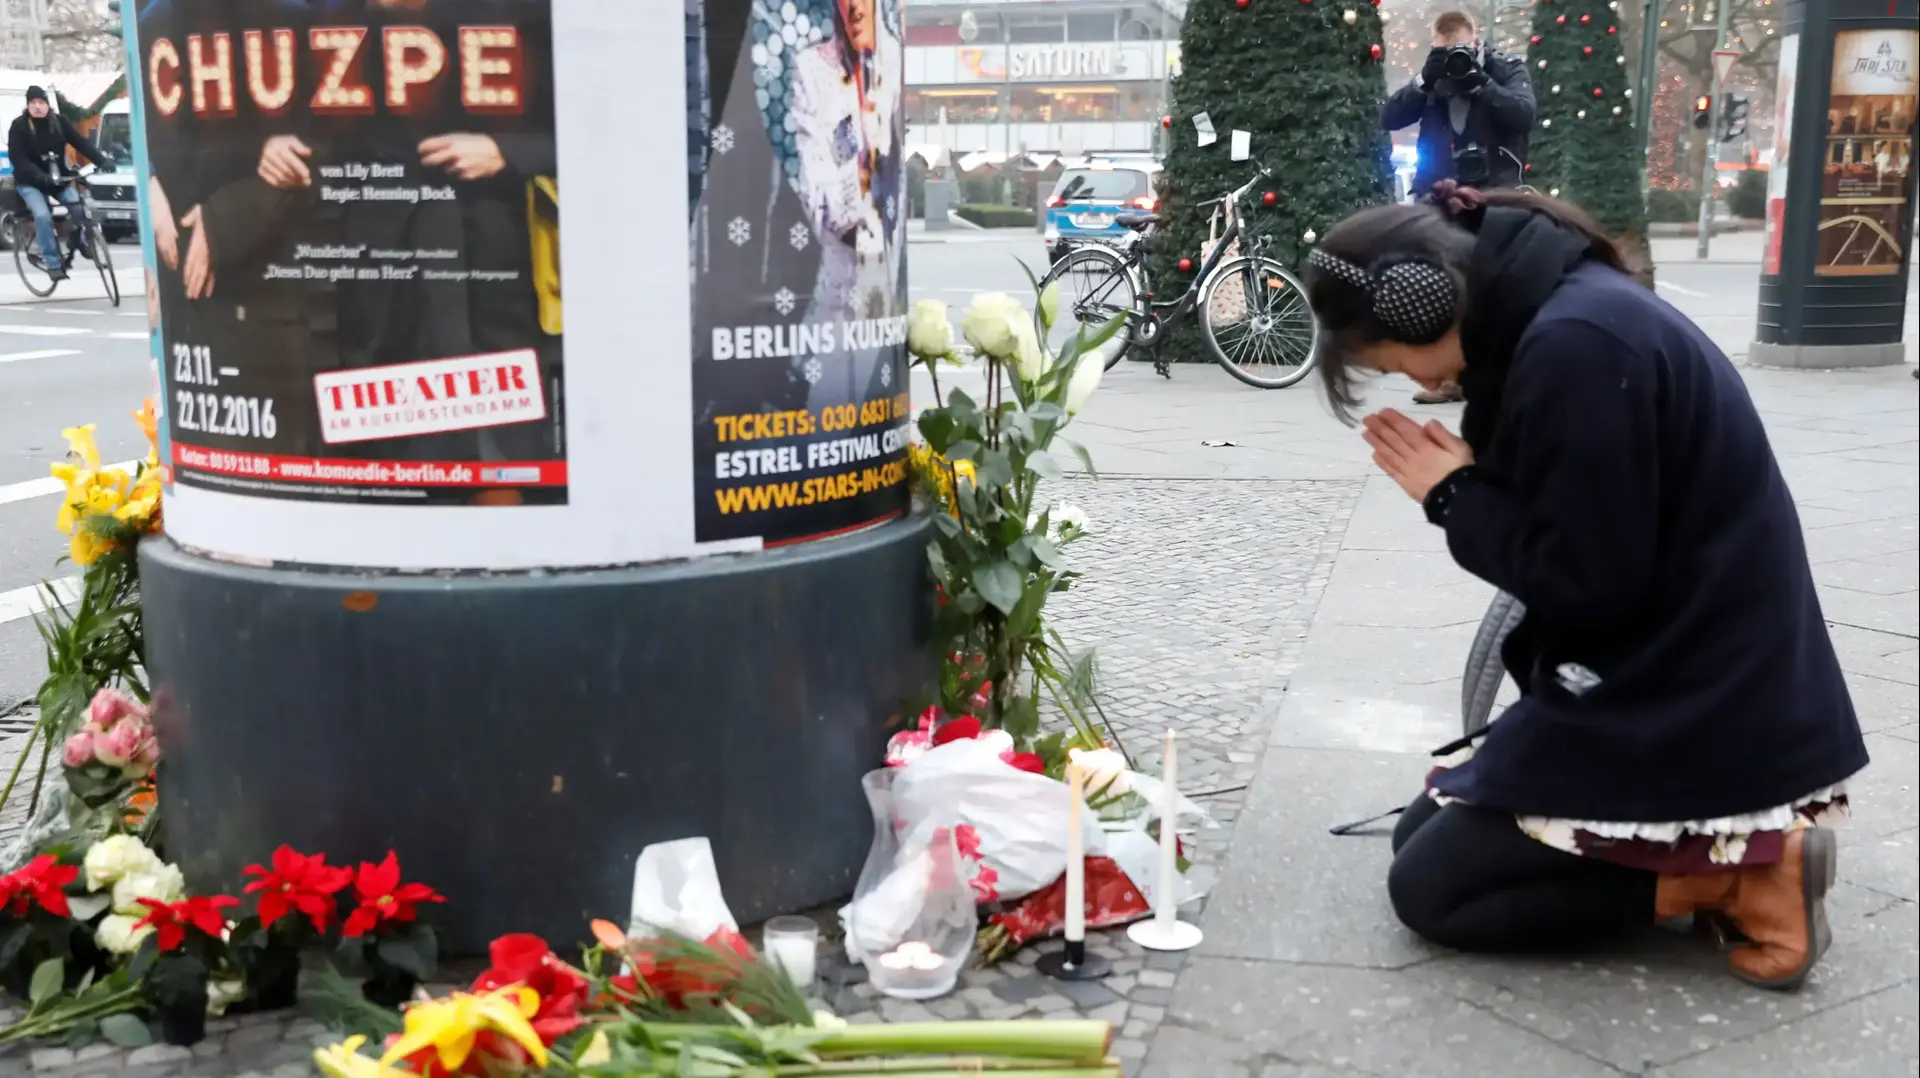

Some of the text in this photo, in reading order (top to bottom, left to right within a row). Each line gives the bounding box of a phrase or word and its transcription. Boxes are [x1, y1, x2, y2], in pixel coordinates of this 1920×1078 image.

[148, 26, 522, 115] CHUZPE
[1010, 48, 1111, 78] SATURN
[319, 162, 405, 180] von Lily Brett
[321, 184, 456, 203] Regie: Henning Bock
[305, 264, 329, 279] Duo
[711, 321, 836, 361] BERLINS
[325, 364, 528, 412] THEATER
[176, 389, 278, 439] 22.12.2016
[330, 396, 533, 430] AM KURFÜRSTENDAMM
[713, 408, 816, 443] TICKETS:
[821, 402, 857, 433] 030
[860, 398, 890, 427] 6831
[280, 459, 473, 483] www.komoedie-berlin.de
[715, 445, 802, 480] ESTREL
[807, 432, 880, 470] FESTIVAL
